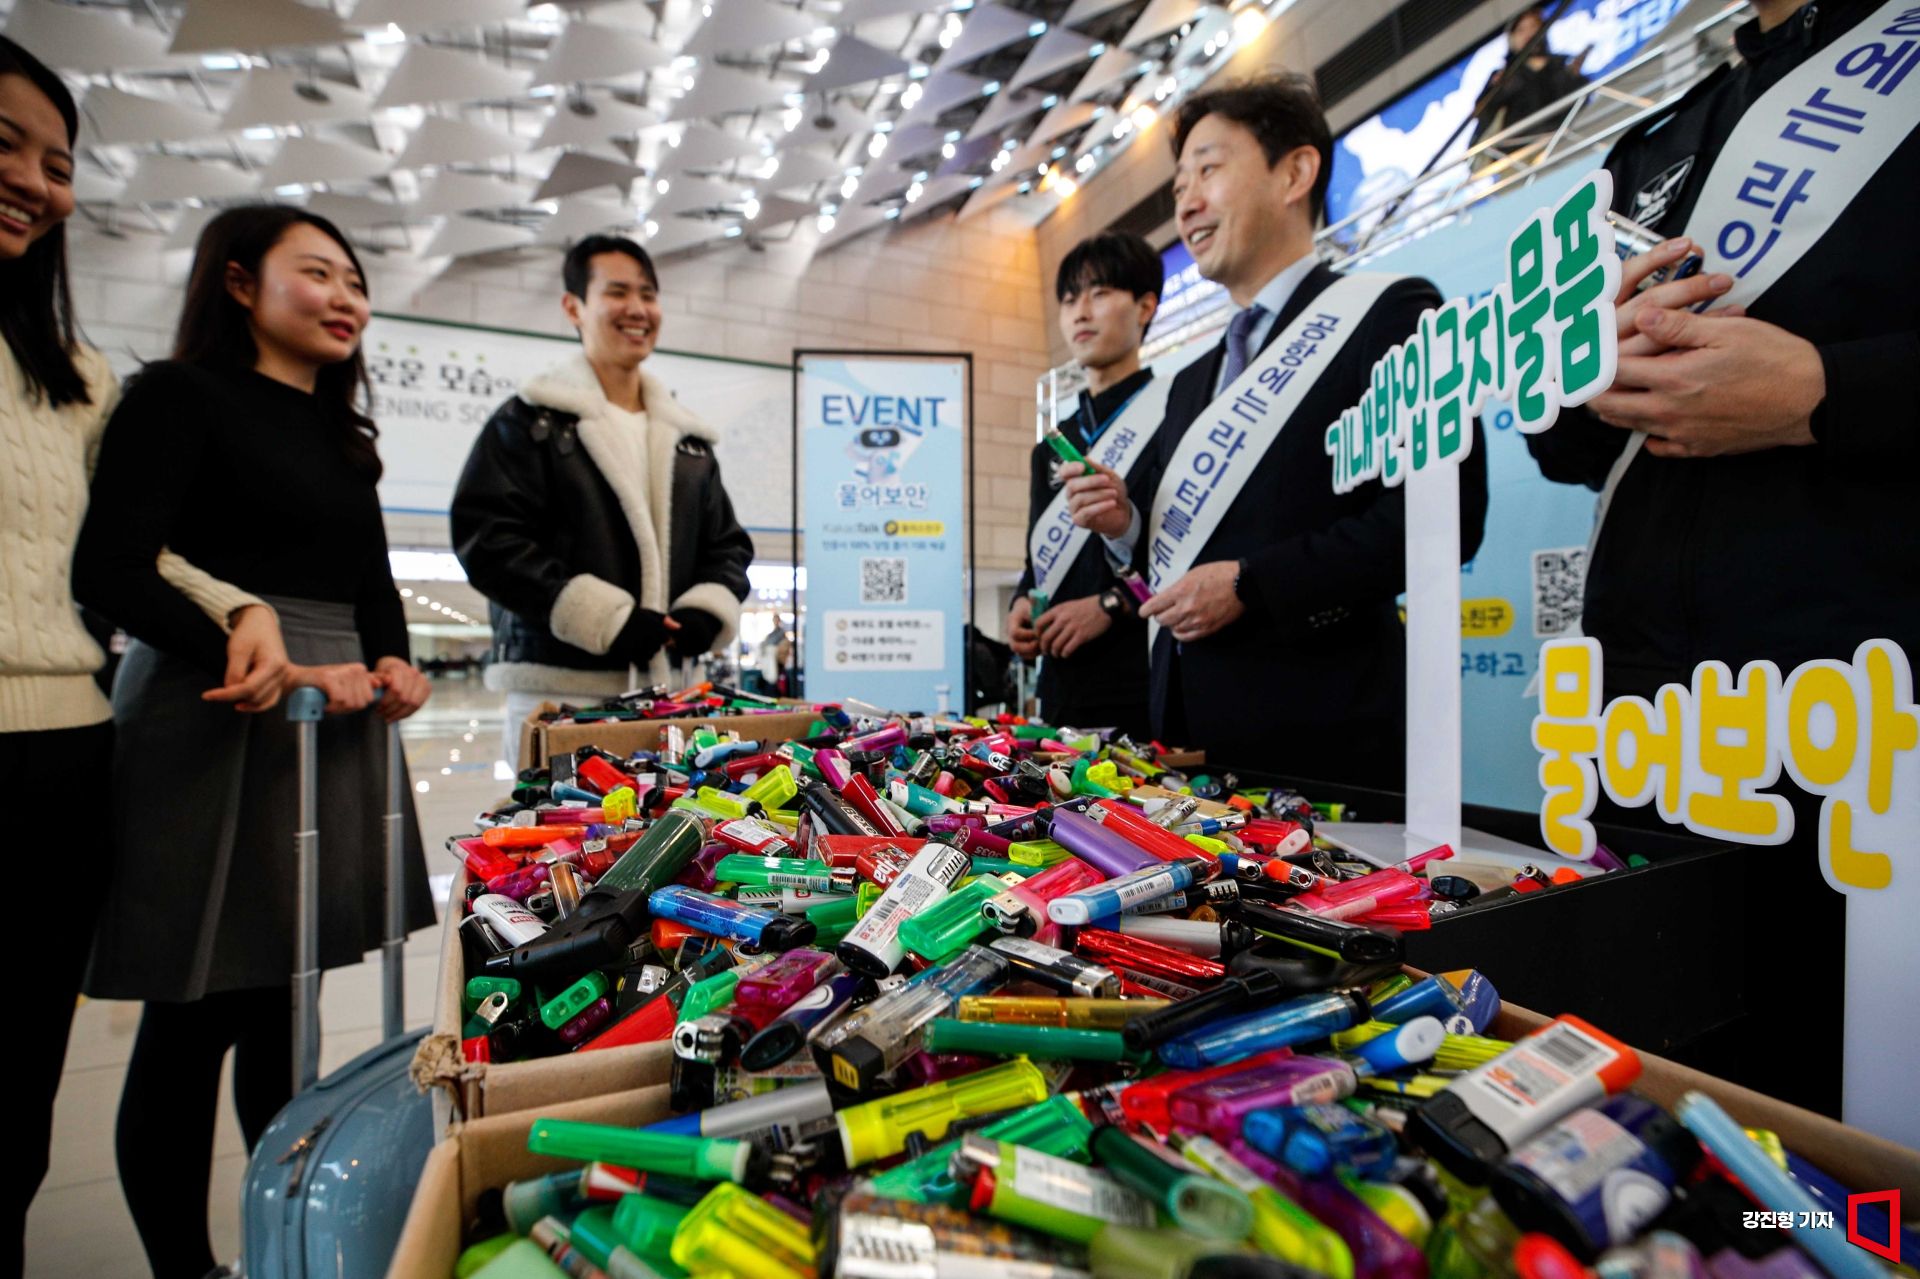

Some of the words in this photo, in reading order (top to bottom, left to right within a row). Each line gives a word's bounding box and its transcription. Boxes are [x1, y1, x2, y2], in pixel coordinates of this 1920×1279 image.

[1706, 160, 1817, 300] 라이
[368, 354, 424, 391] 로운
[822, 394, 946, 427] EVENT
[1231, 313, 1341, 424] 공항에는
[841, 483, 926, 509] 물어보안
[1161, 420, 1247, 543] 라이터를
[1536, 644, 1919, 891] 물어보안
